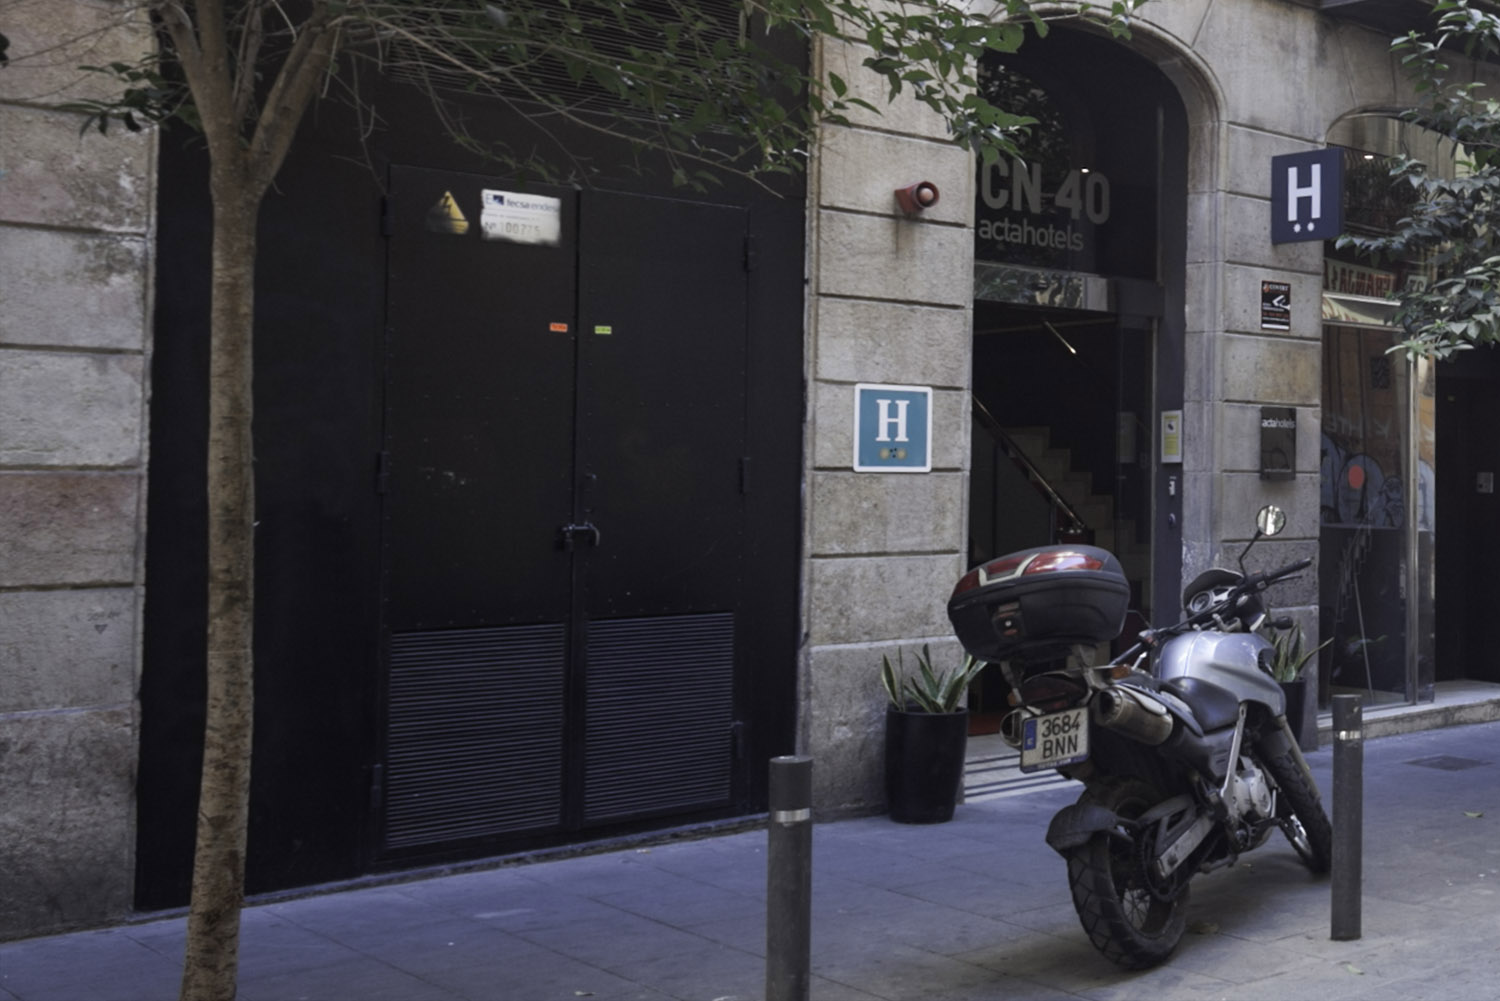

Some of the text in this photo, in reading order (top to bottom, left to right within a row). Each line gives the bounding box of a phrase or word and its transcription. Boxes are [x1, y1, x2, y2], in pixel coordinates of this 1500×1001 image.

[1055, 168, 1111, 225] 40
[1286, 163, 1322, 222] H
[979, 217, 1084, 250] actahotels
[874, 399, 911, 442] H
[1041, 711, 1081, 738] 3684
[1042, 734, 1079, 759] BNN
